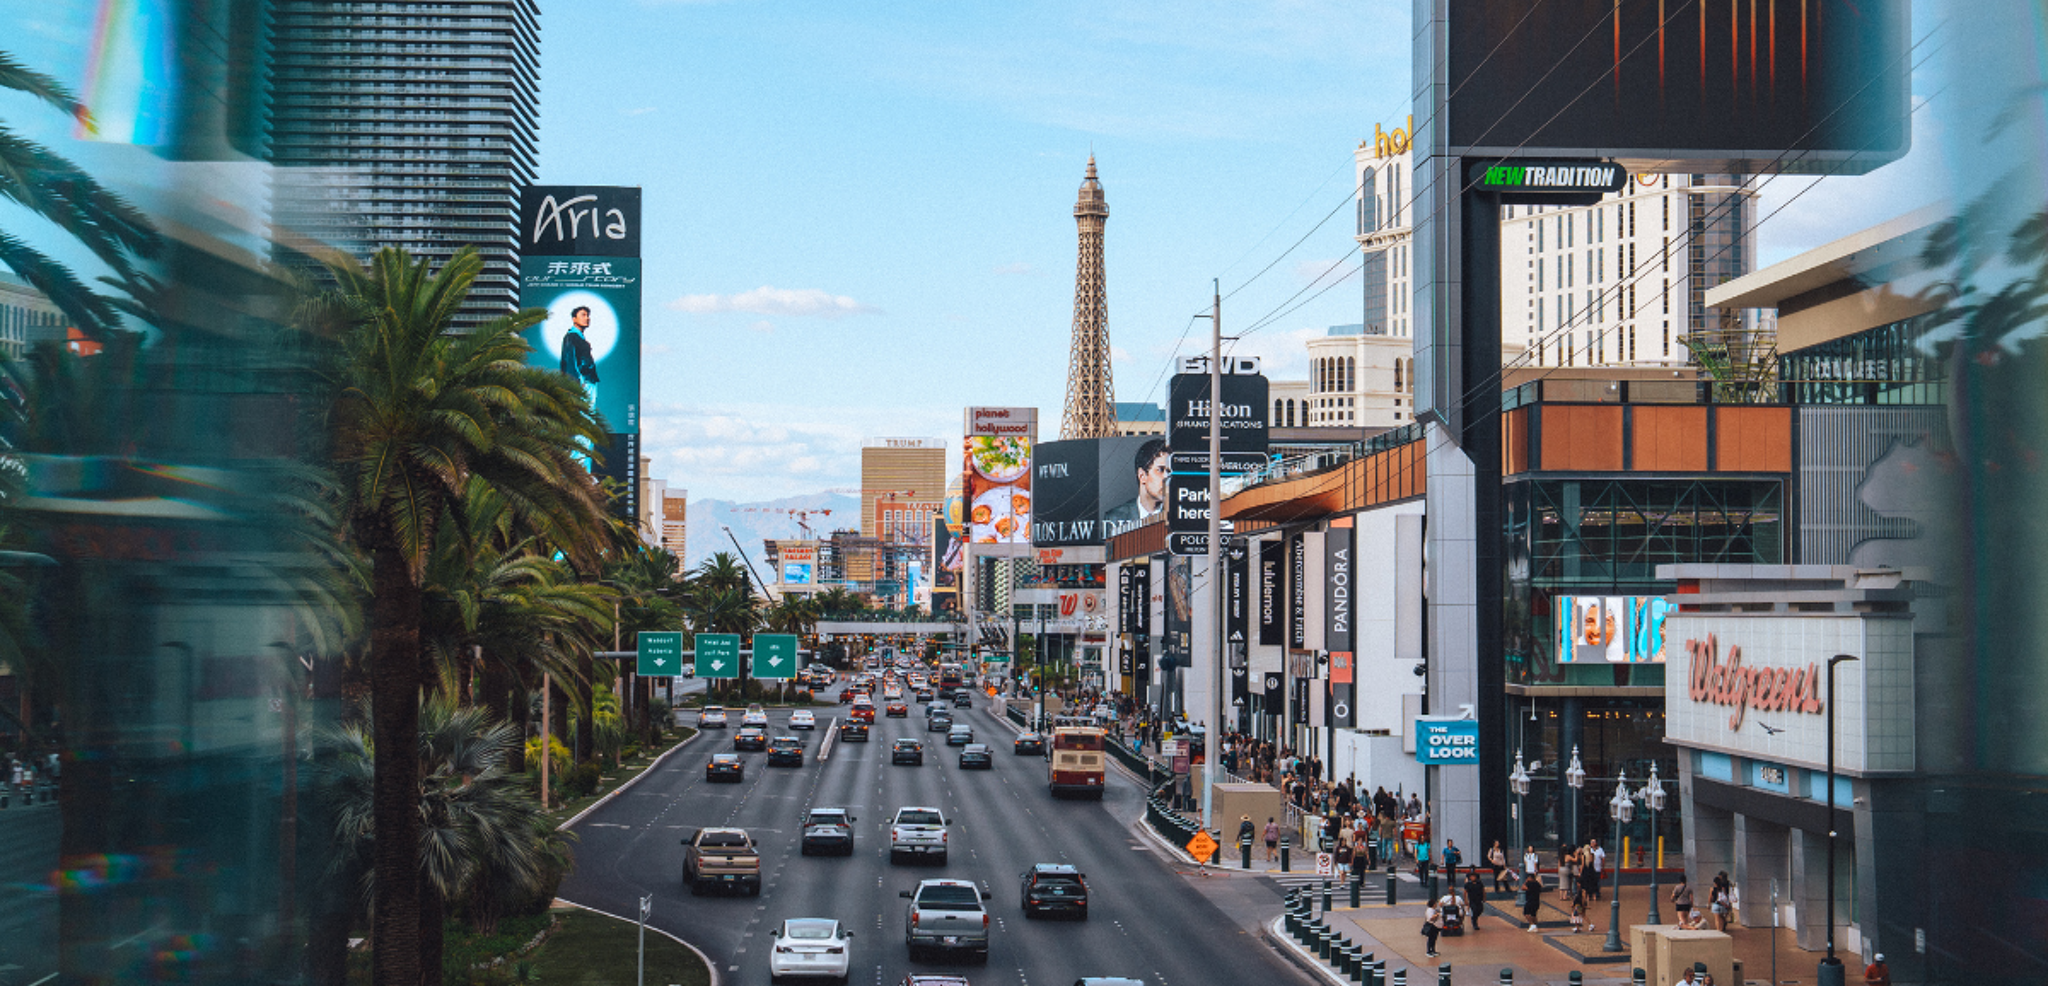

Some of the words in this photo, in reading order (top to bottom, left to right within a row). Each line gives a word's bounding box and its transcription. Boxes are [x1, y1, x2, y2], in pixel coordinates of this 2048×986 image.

[533, 194, 626, 243] Aria
[976, 408, 1010, 420] planet
[1188, 399, 1252, 418] Hiton
[976, 423, 1028, 434] hollywood
[1218, 420, 1263, 429] ACATIONS
[886, 439, 923, 448] TRUMP
[1178, 487, 1211, 502] Park
[1178, 504, 1211, 519] here
[1264, 561, 1276, 625] lululemon
[1685, 632, 1822, 732] Walgreens
[1429, 735, 1475, 746] OVER
[1429, 747, 1476, 759] LOOK
